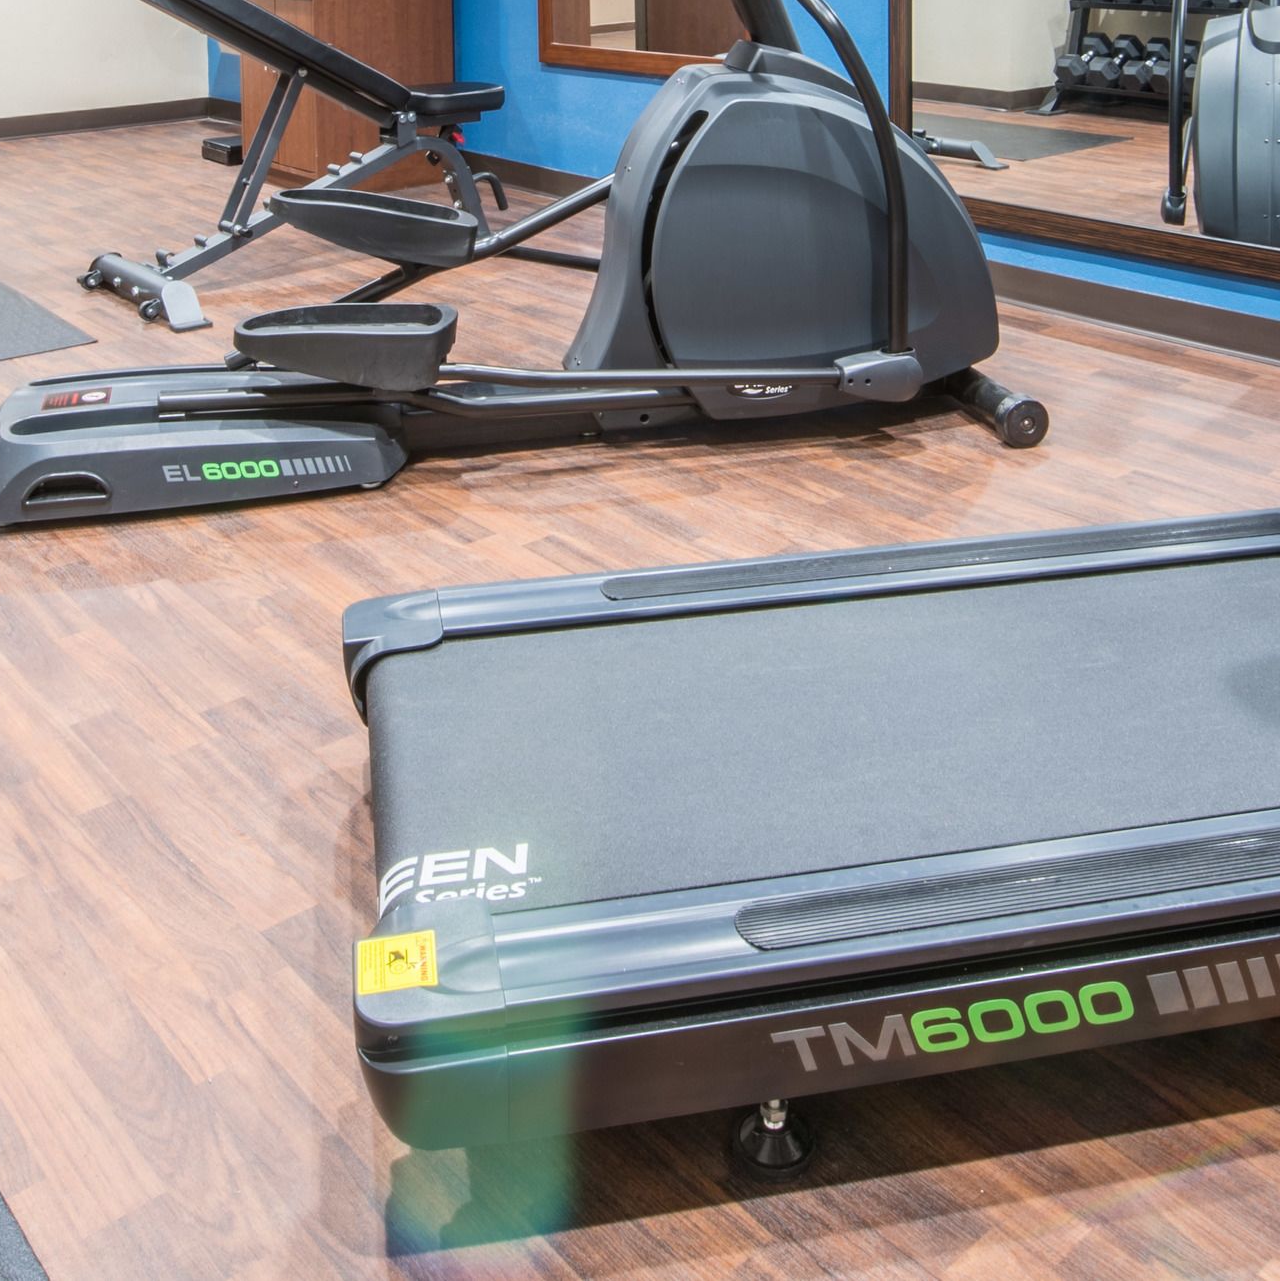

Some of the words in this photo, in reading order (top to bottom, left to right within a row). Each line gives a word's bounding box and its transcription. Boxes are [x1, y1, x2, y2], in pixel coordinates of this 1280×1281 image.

[161, 459, 280, 483] EL6000
[377, 842, 529, 919] EEN
[770, 980, 1135, 1072] TM6000
